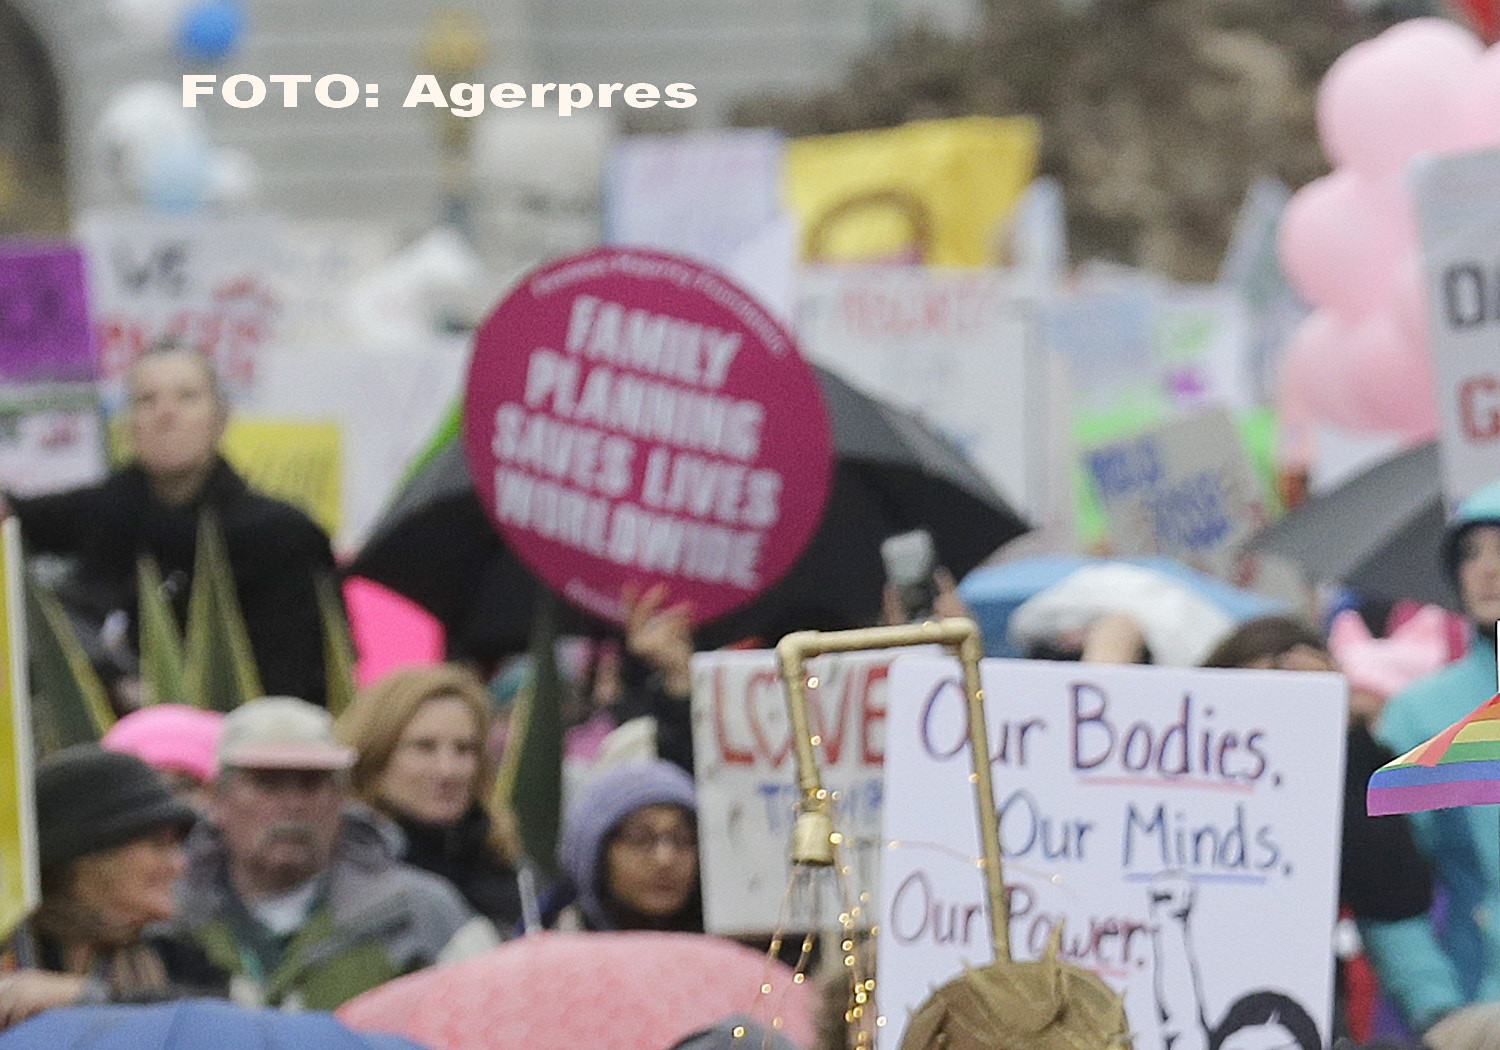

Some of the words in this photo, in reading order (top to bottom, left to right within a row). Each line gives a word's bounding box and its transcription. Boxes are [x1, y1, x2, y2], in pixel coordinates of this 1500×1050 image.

[563, 295, 743, 388] FAMILY
[522, 347, 765, 463] PLANNING
[490, 400, 637, 500] SAVES
[640, 447, 783, 530] LIVES
[492, 462, 765, 592] WORLDWIDE
[919, 677, 1048, 766] Our
[1068, 682, 1285, 788] Bodies.
[995, 790, 1093, 862] Our
[1122, 801, 1295, 876] Minds.
[891, 868, 984, 944] Our
